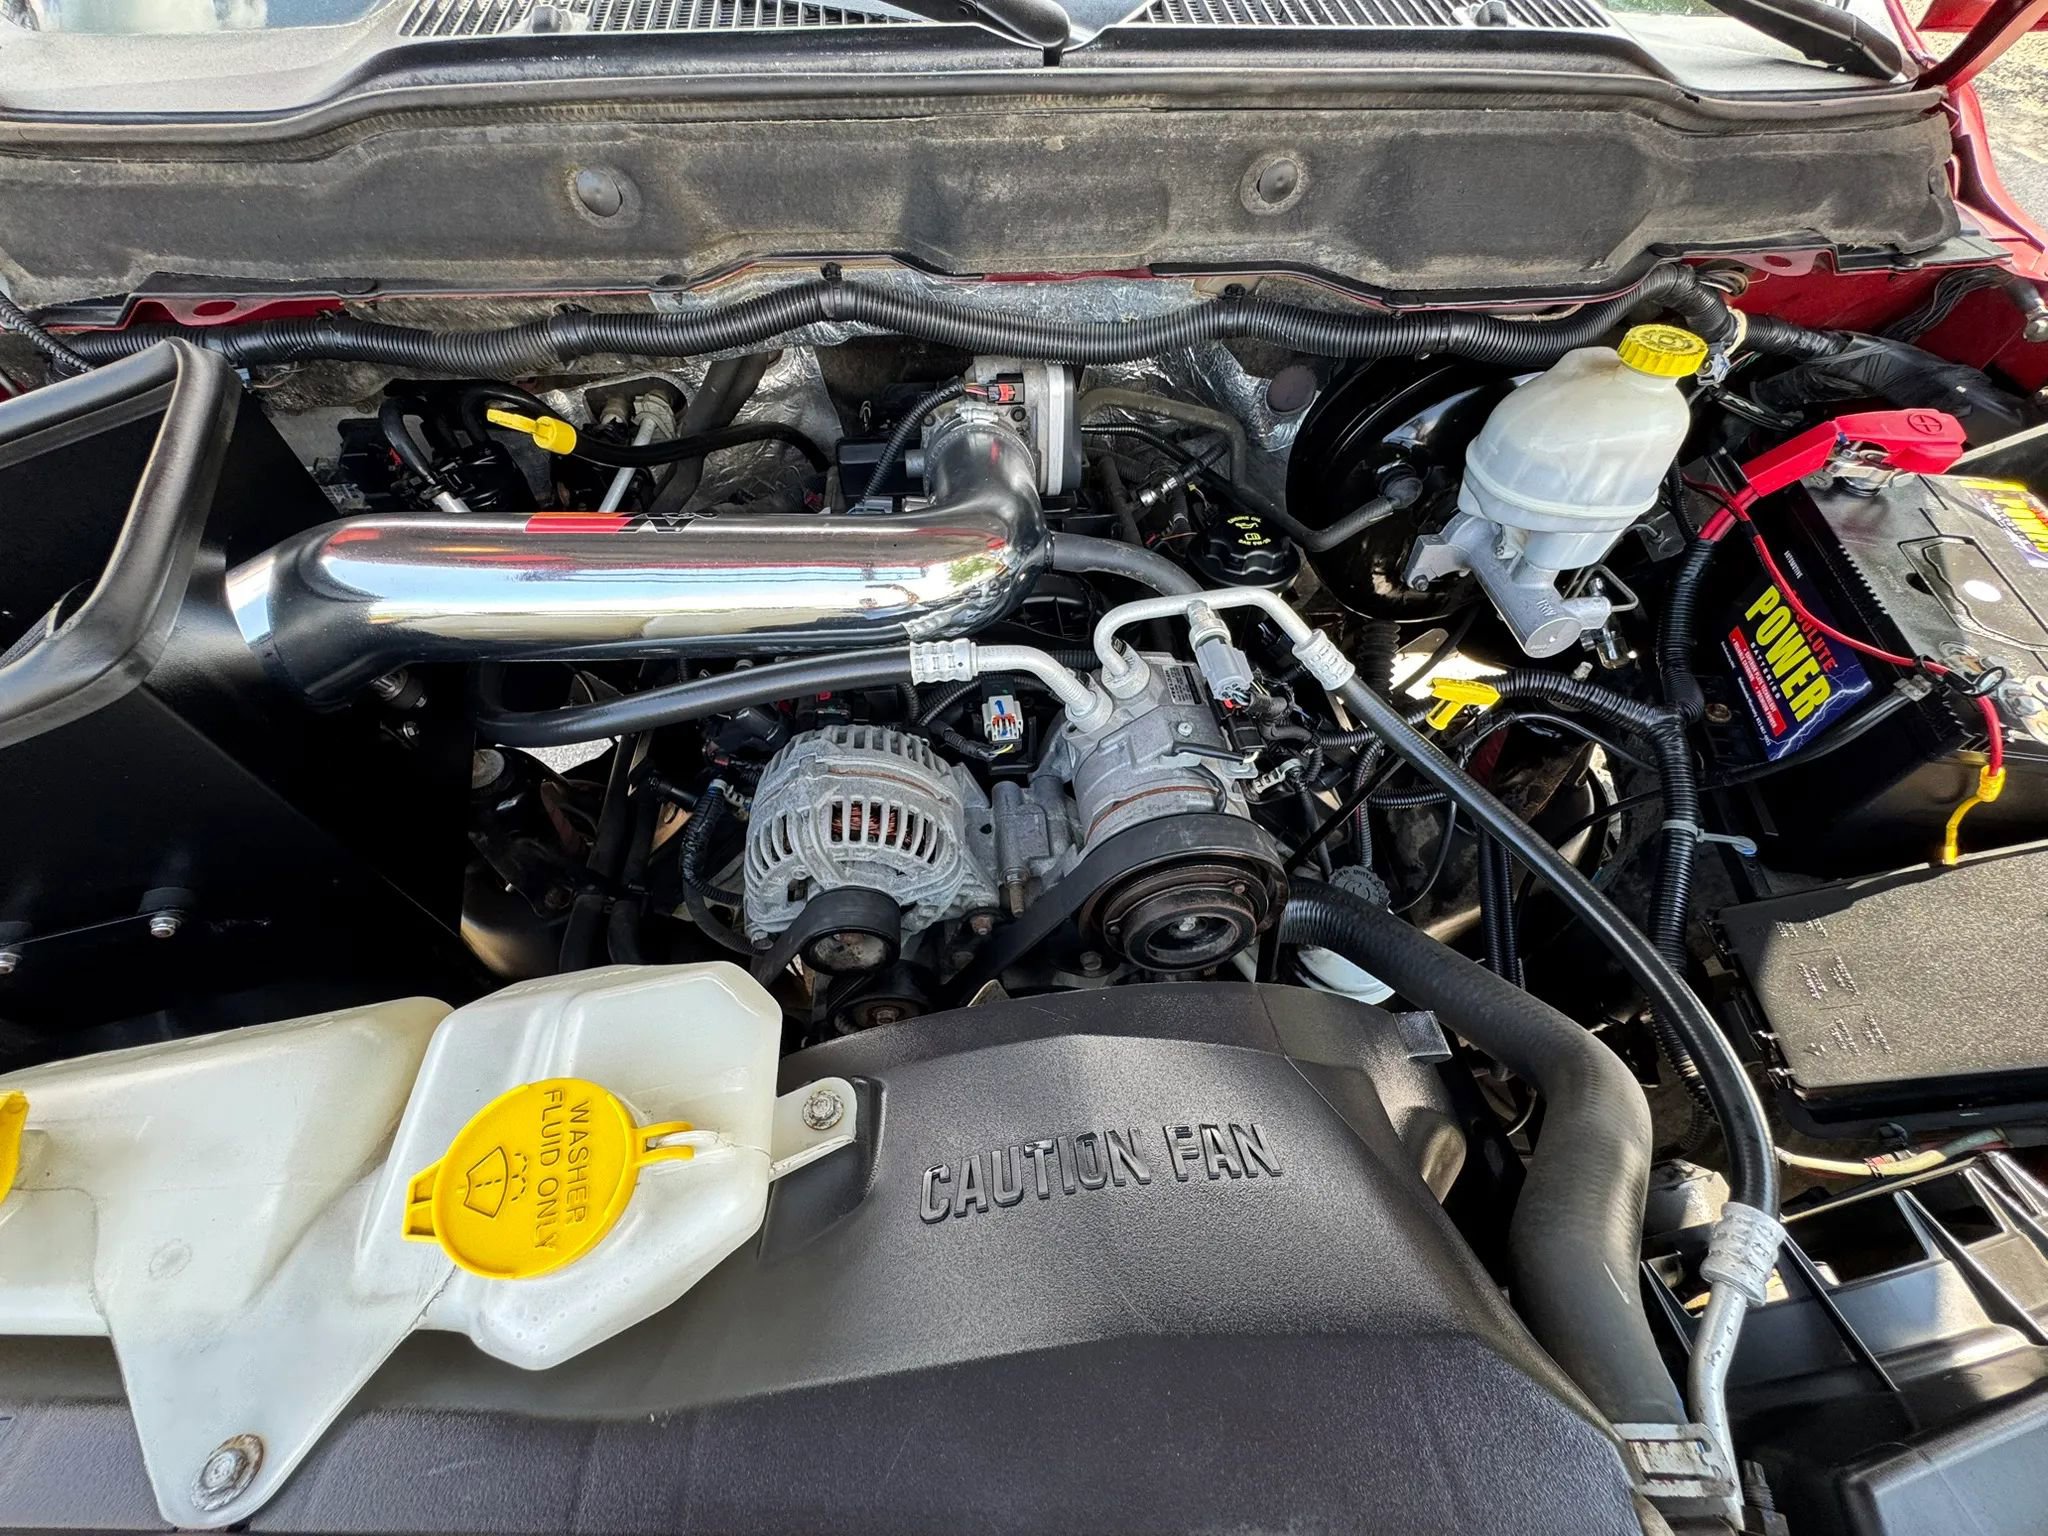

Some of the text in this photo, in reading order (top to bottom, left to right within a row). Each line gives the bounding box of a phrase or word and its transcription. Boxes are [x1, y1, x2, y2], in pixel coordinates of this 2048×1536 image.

[1745, 586, 1832, 722] POWER
[1750, 641, 1781, 700] BATTERIES
[535, 1089, 563, 1249] FLUID ONLY
[566, 1100, 592, 1225] WASHER
[919, 1123, 1283, 1224] CAUTION FAN
